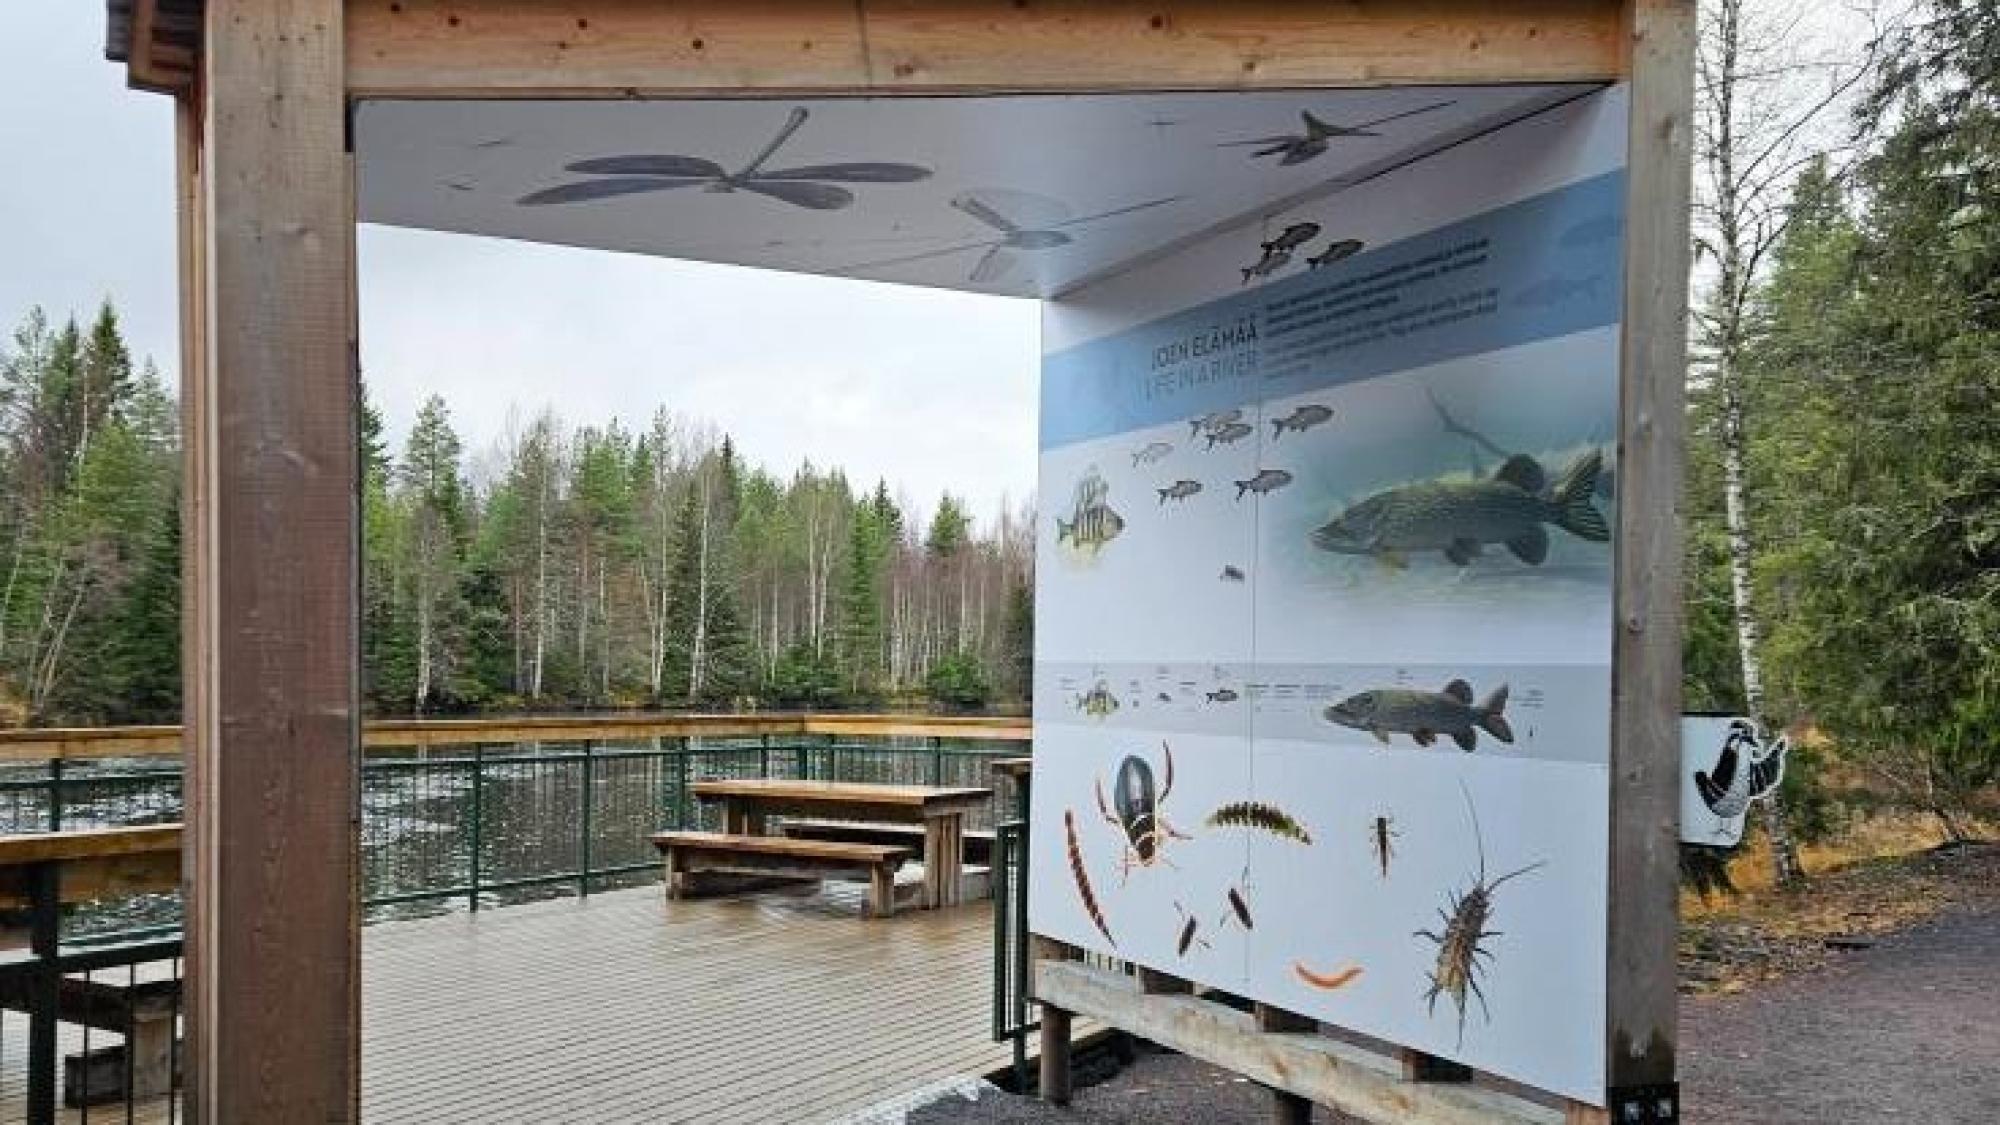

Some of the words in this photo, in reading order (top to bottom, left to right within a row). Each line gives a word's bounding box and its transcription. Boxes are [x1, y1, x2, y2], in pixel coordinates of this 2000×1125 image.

[1151, 341, 1188, 371] JOEN
[1192, 312, 1257, 356] ELÄMÄÄ
[1211, 347, 1258, 383] RIVER
